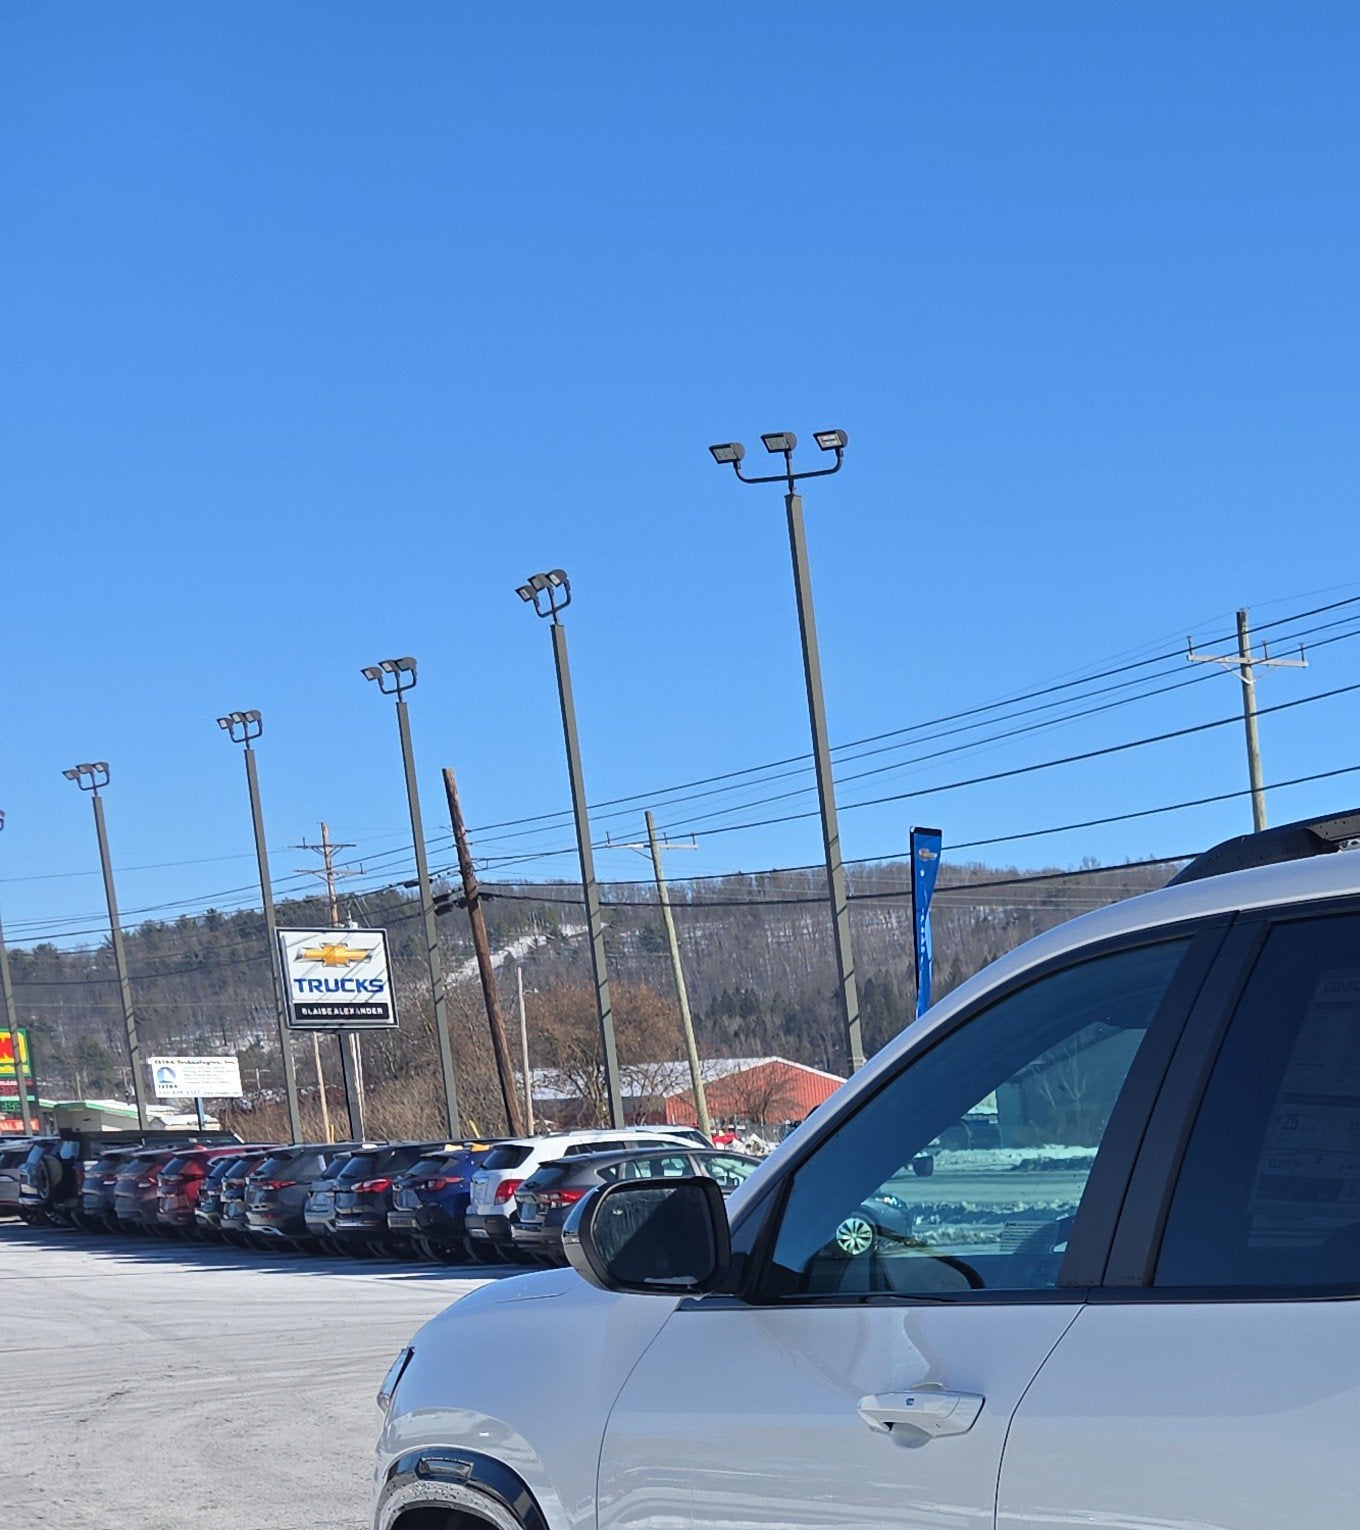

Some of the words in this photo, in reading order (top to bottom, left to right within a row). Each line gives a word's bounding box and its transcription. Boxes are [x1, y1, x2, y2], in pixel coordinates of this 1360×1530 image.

[294, 978, 385, 993] TRUCKS
[301, 1007, 332, 1016] BLAISE
[333, 1007, 383, 1016] ALEXANDER
